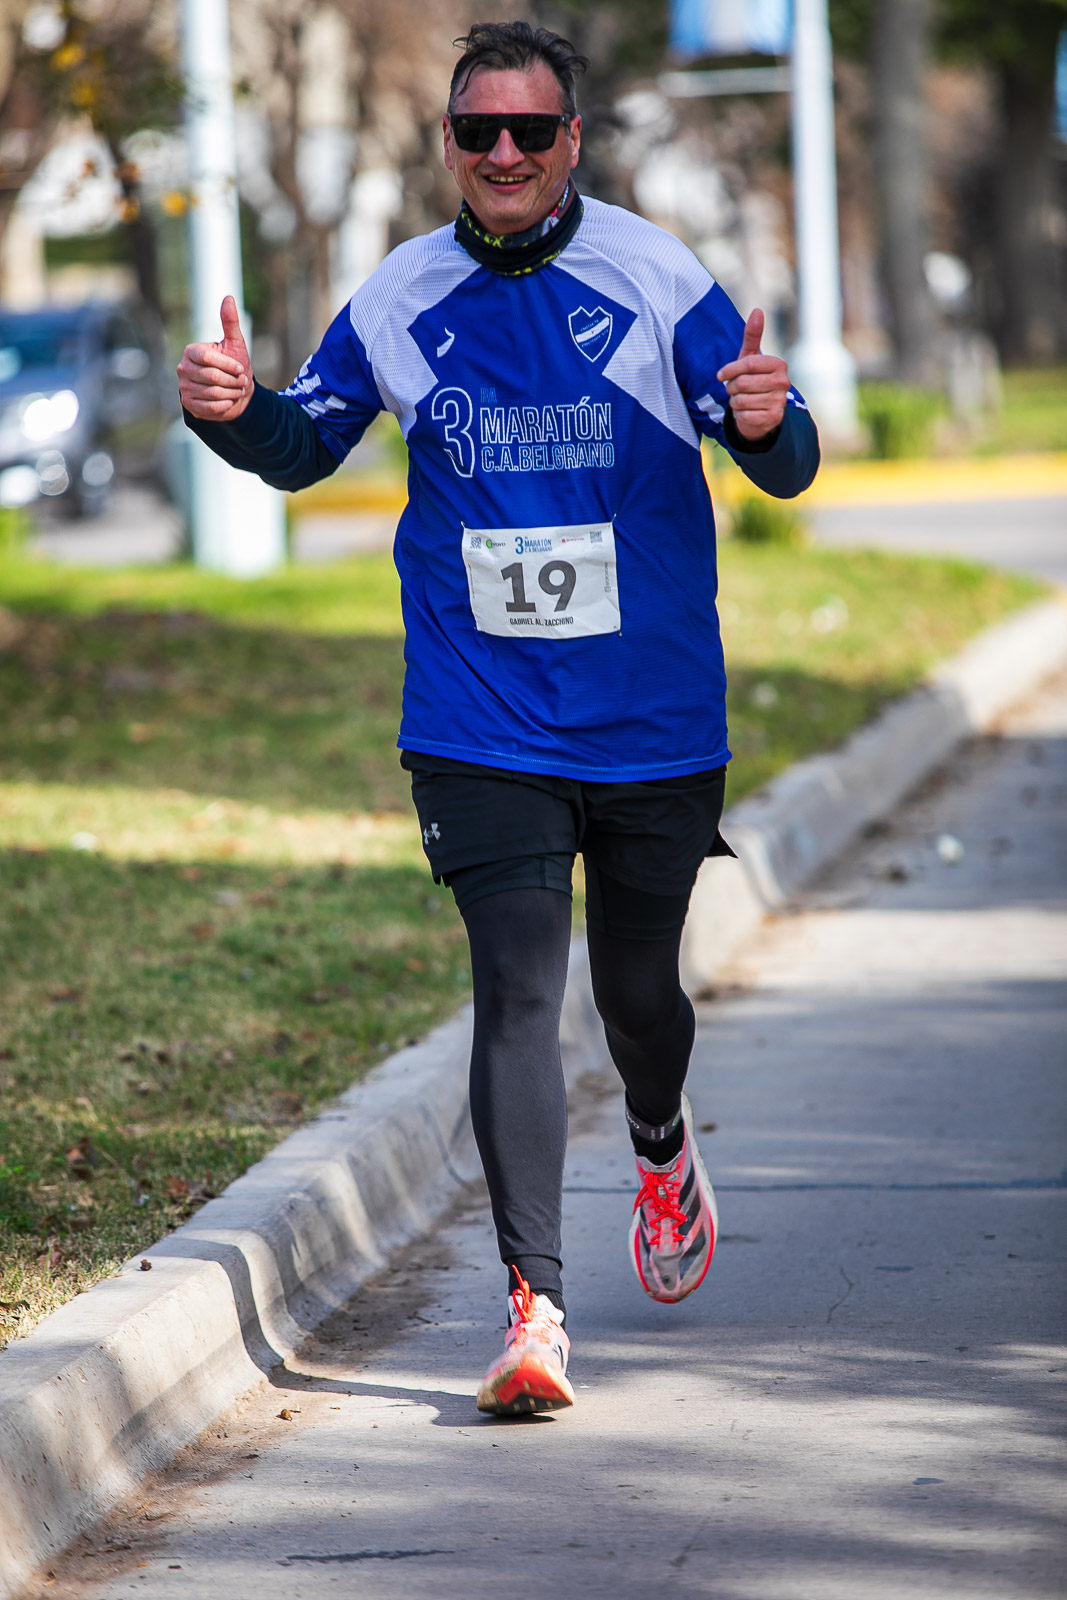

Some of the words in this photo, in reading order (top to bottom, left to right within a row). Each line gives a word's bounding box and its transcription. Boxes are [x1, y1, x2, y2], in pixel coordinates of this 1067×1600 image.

[431, 387, 475, 478] 3
[480, 396, 613, 443] MARATÓN
[514, 536, 524, 554] 3
[524, 538, 552, 548] MARATÓN
[501, 560, 576, 612] 19
[509, 617, 534, 626] GABRIEL
[544, 616, 574, 627] ZACCHINO
